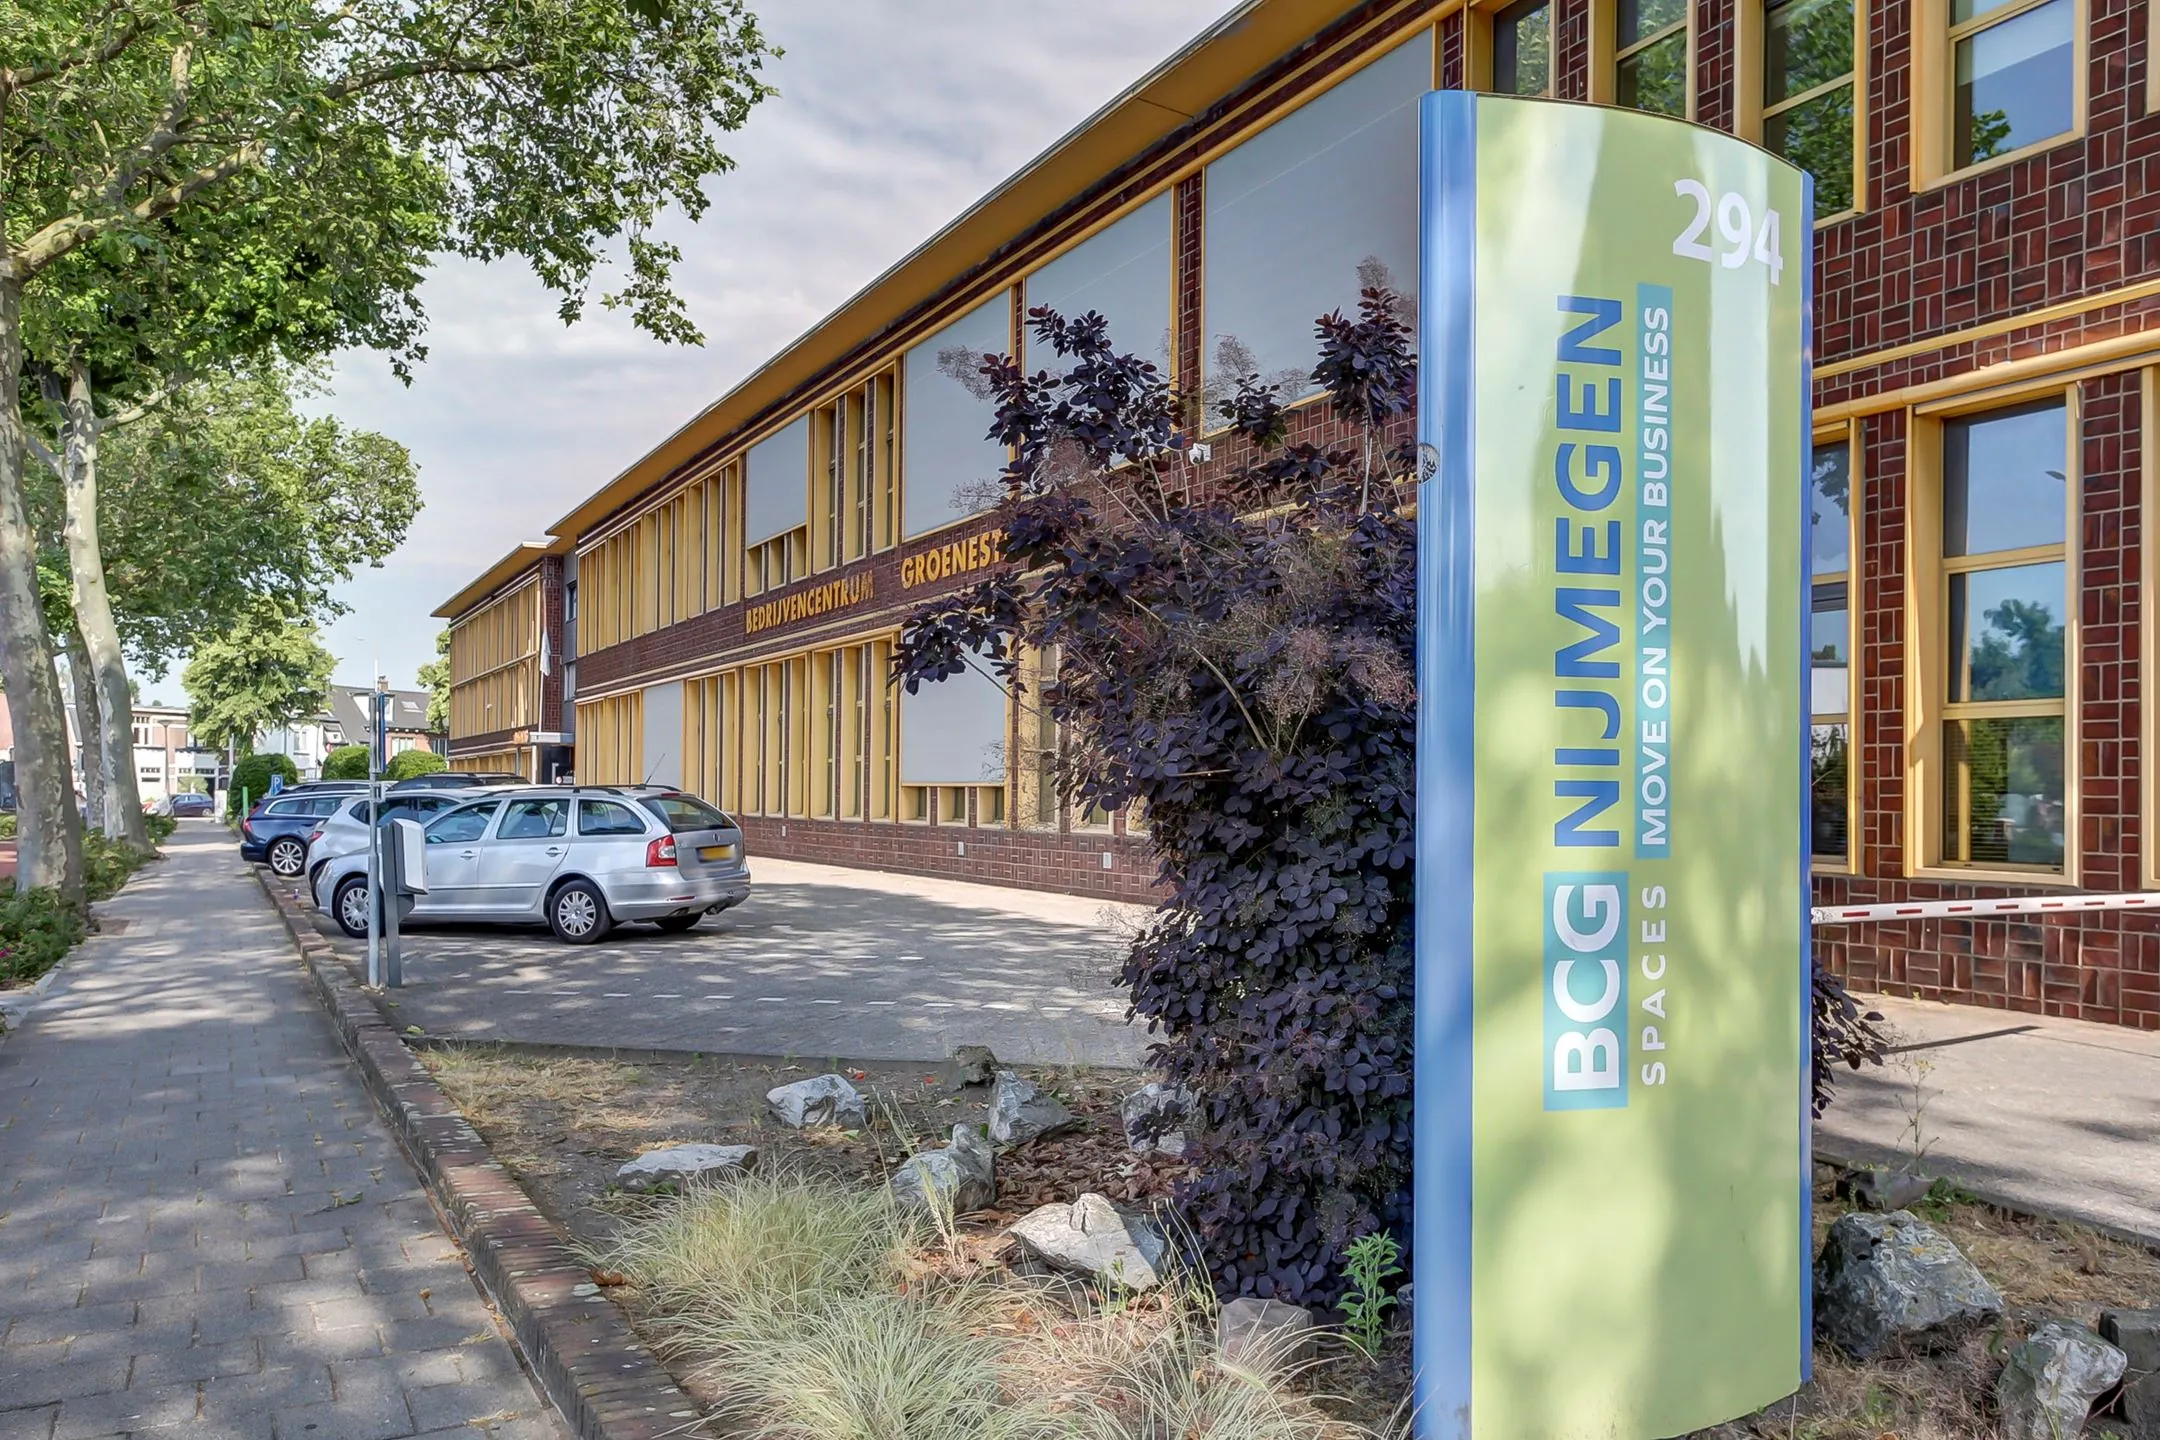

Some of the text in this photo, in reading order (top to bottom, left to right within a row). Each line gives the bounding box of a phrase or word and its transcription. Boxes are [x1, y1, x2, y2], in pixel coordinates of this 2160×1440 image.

[1672, 179, 1784, 286] 294
[746, 570, 874, 634] BEDRIJVENCENTRUM
[901, 528, 1007, 590] GROENEST
[1642, 307, 1669, 845] MOVE ON YOUR BUSINESS
[1553, 295, 1622, 1091] BCG NIJMEGEN
[1642, 885, 1667, 1086] SPACES
